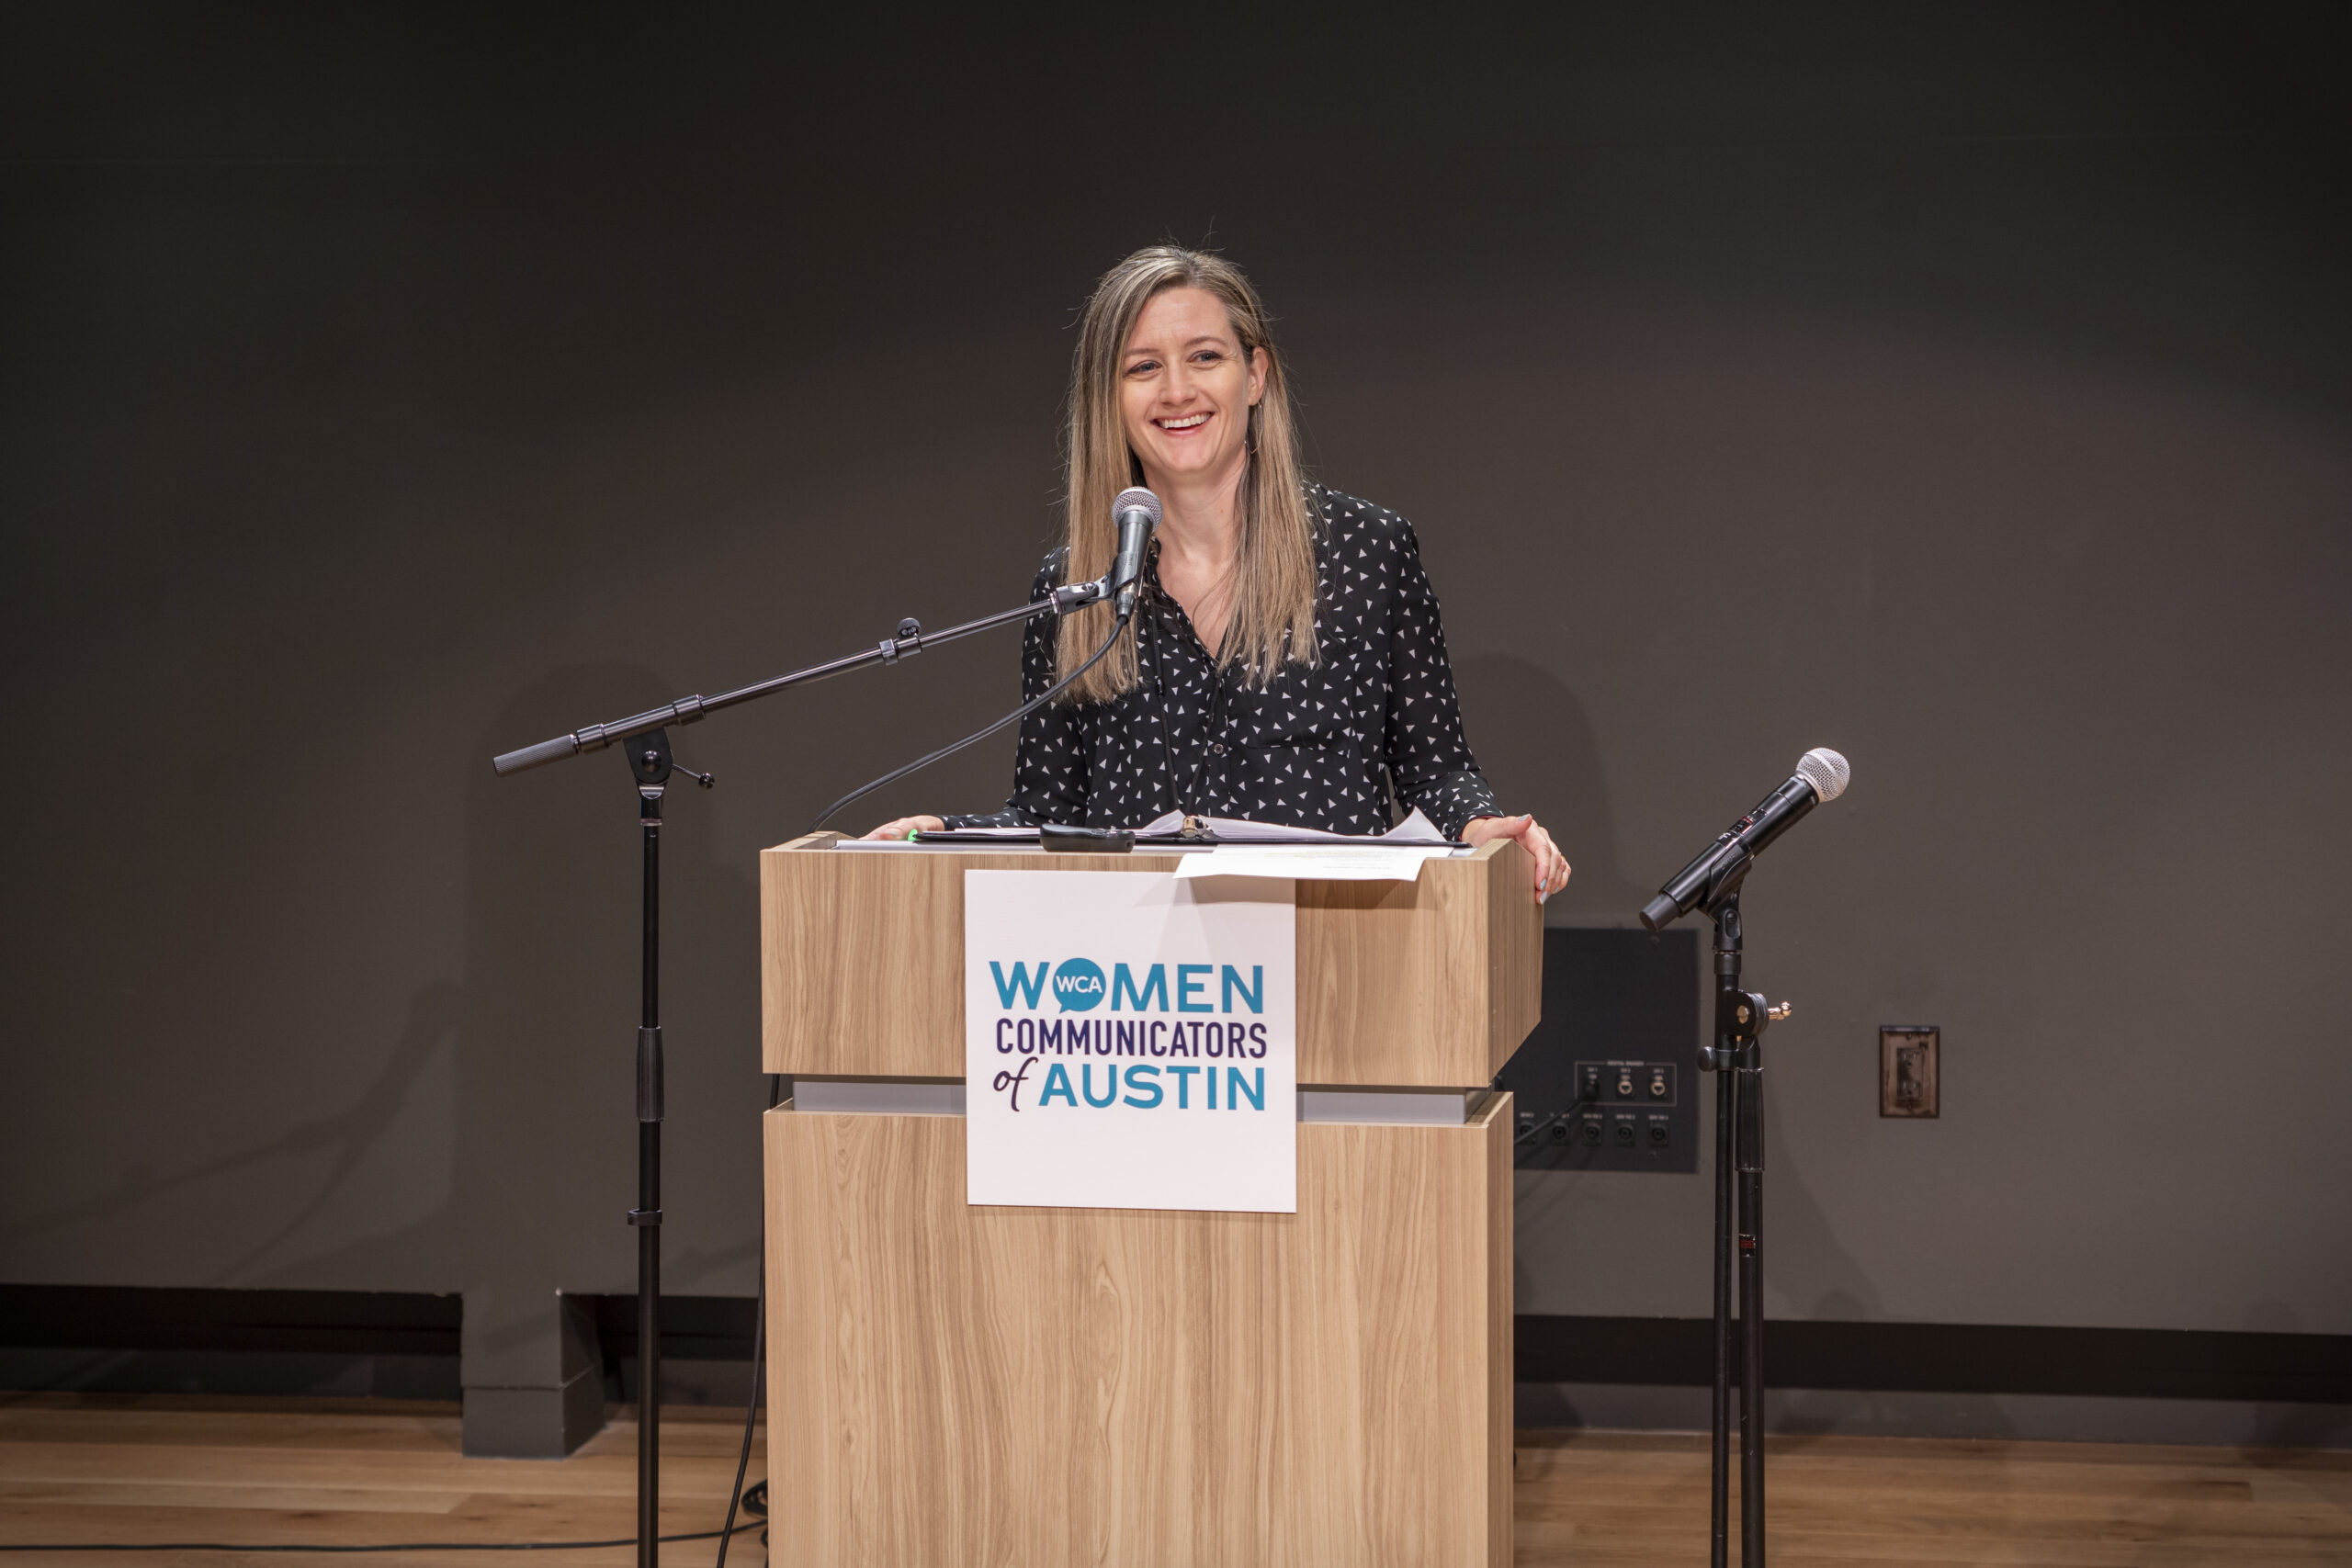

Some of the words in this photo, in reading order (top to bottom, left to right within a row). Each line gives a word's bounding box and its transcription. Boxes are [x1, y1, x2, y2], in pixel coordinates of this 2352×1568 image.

[1056, 976, 1102, 994] WCA
[996, 1018, 1267, 1059] COMMUNICATORS
[993, 1056, 1038, 1112] of
[1038, 1063, 1265, 1111] AUSTIN
